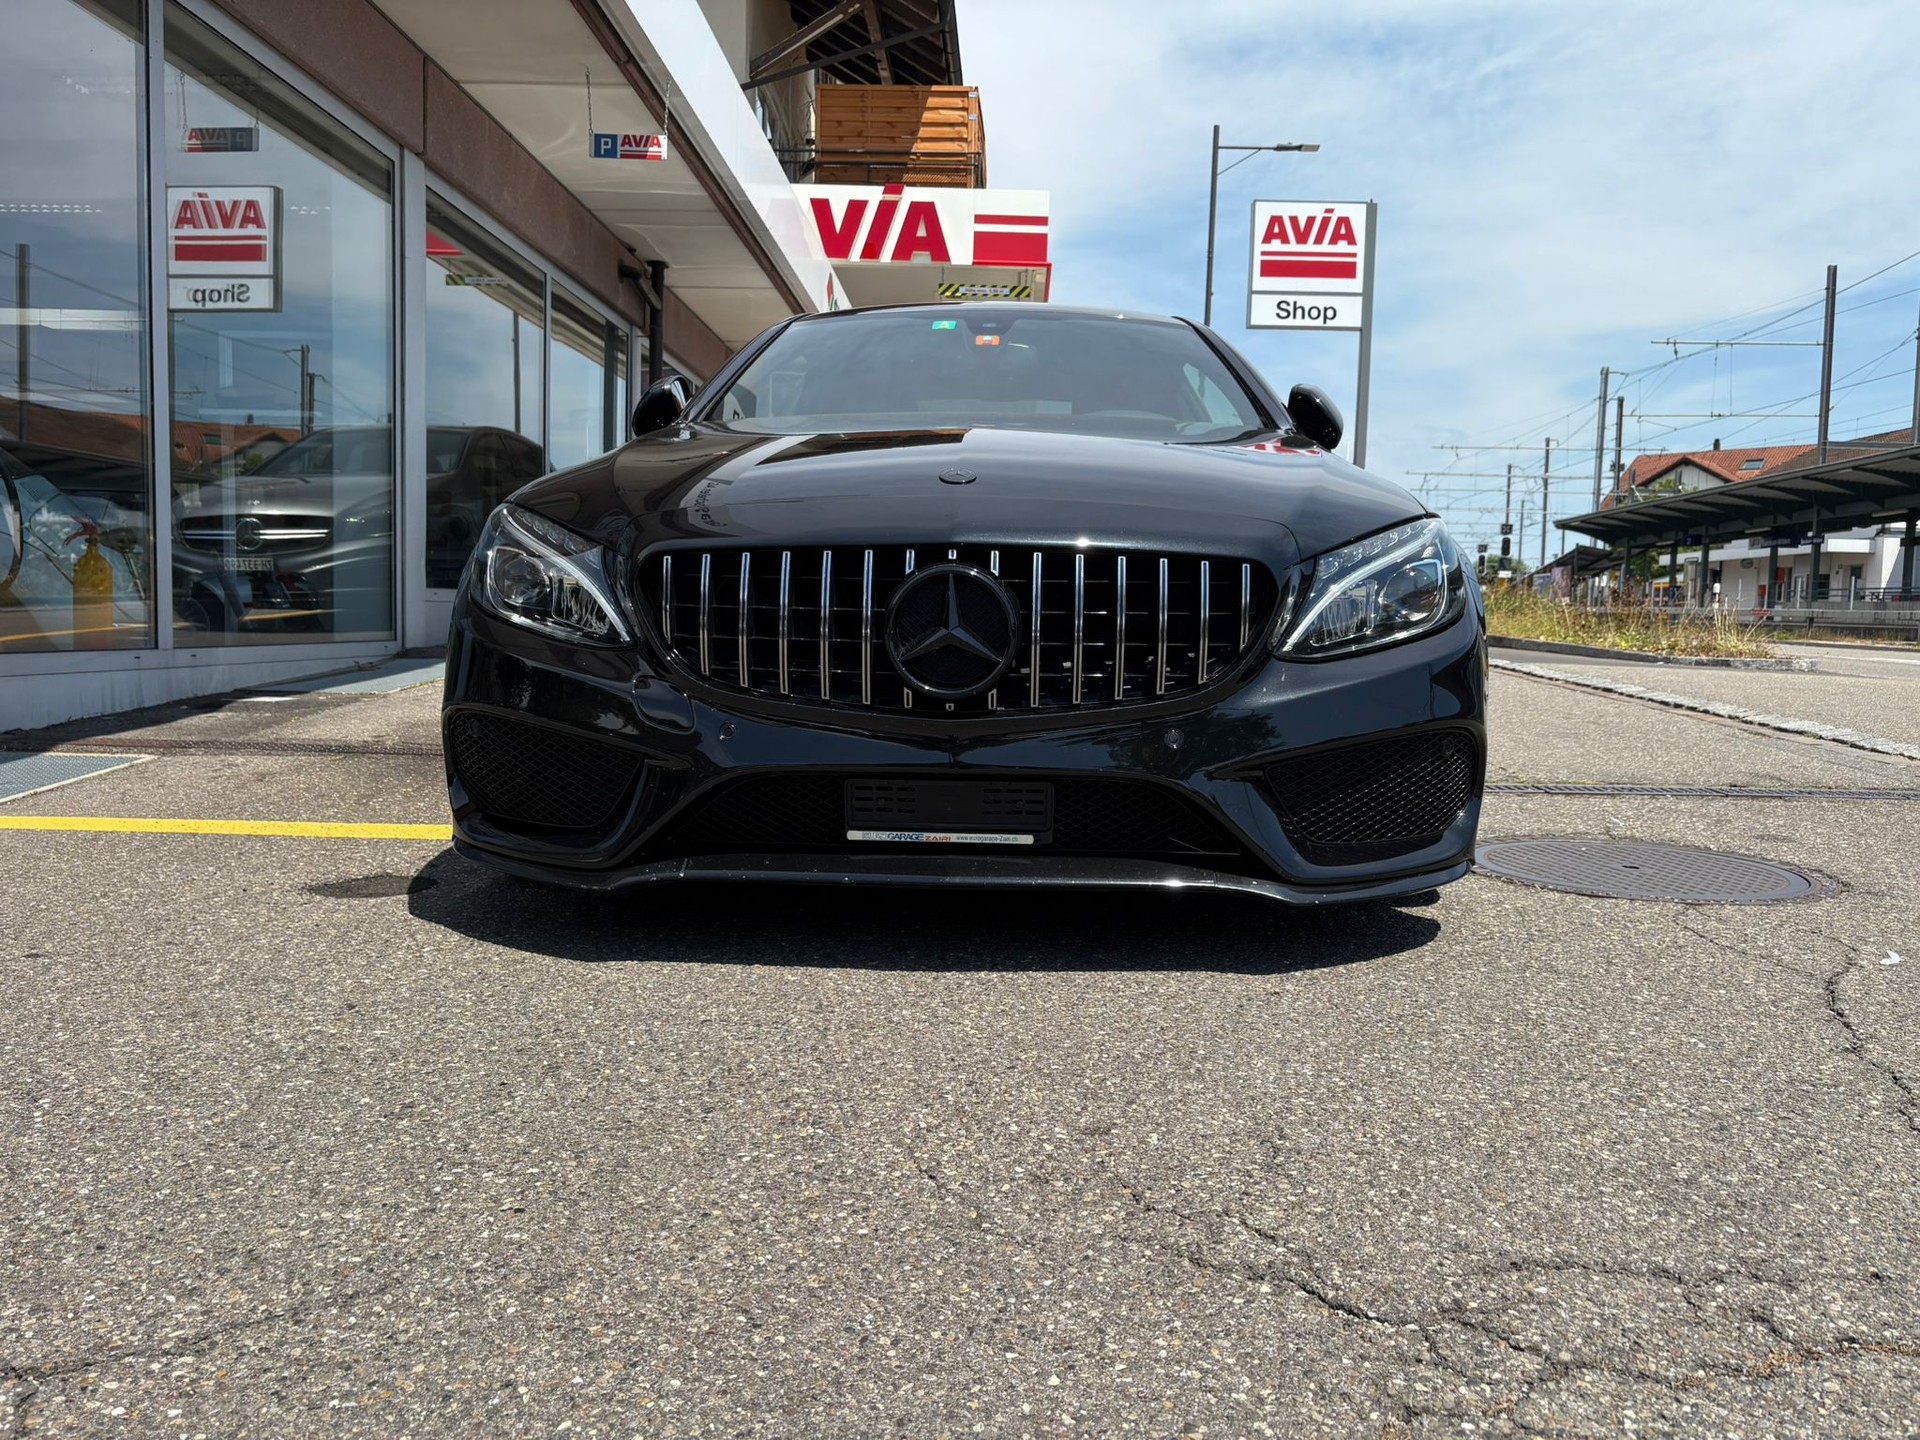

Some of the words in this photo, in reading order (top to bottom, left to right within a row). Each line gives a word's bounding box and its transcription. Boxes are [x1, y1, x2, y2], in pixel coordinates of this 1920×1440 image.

[600, 138, 612, 155] P
[620, 134, 662, 148] AVIA
[1261, 208, 1357, 246] AVIA
[1275, 300, 1337, 325] Shop
